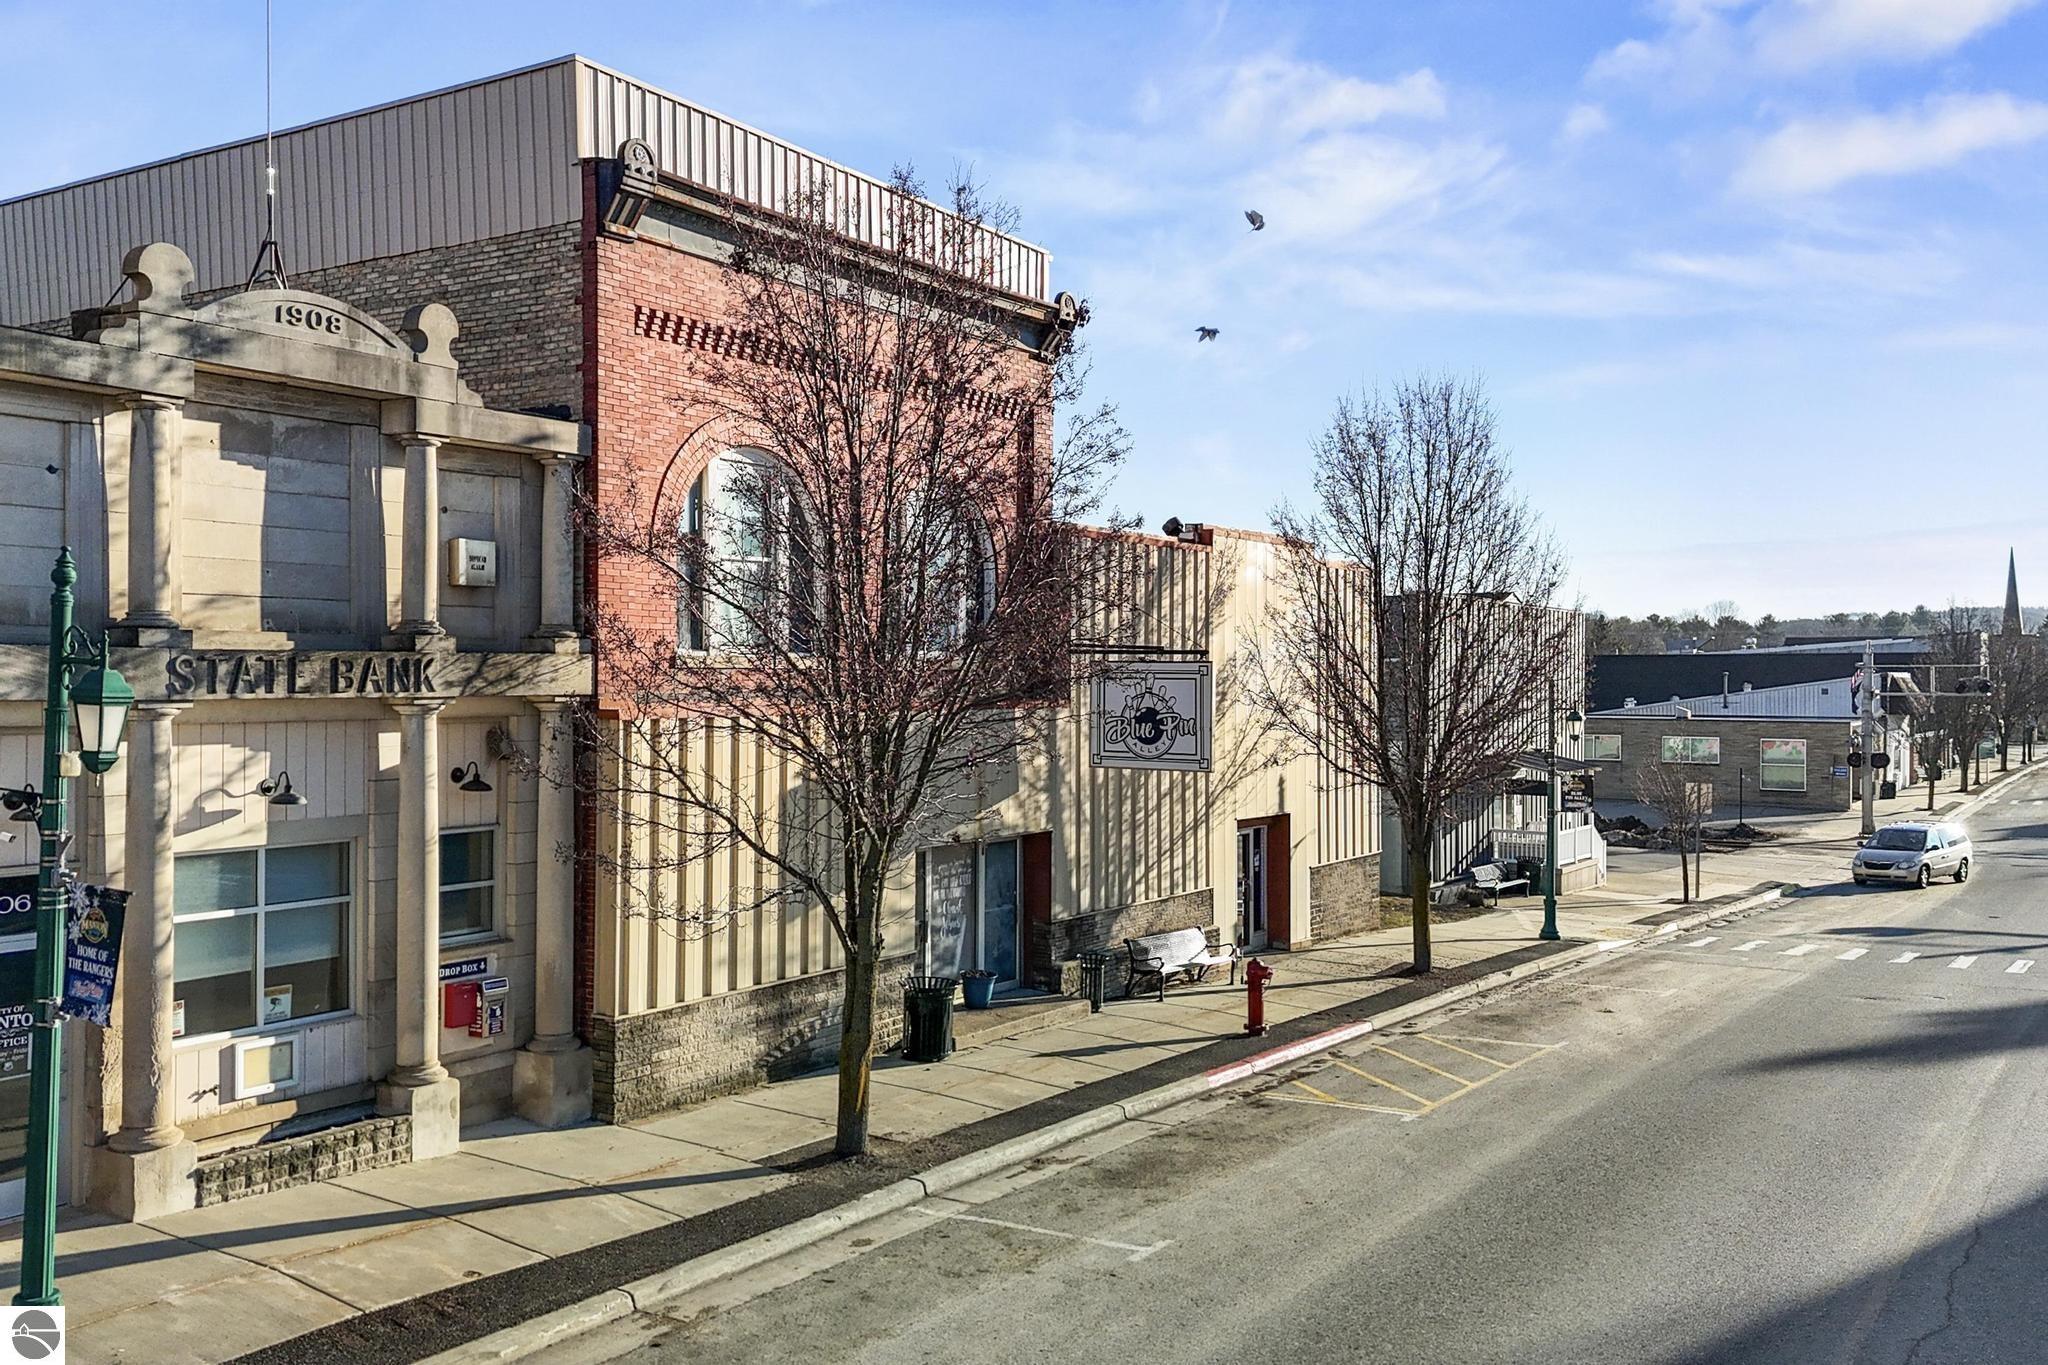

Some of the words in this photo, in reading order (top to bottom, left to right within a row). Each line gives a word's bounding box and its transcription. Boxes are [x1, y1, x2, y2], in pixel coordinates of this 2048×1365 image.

[275, 304, 342, 334] 1908
[165, 653, 307, 695] STATE
[330, 656, 437, 694] BANK
[1104, 715, 1155, 744] Blue
[1156, 712, 1197, 741] Pin
[1132, 740, 1168, 754] ALLEY
[77, 944, 97, 960] HOME
[98, 949, 109, 962] OF
[68, 957, 82, 971] THE
[83, 960, 115, 979] RANGERS
[439, 966, 461, 977] DROP
[462, 963, 478, 973] BOX
[13, 1005, 25, 1013] OF
